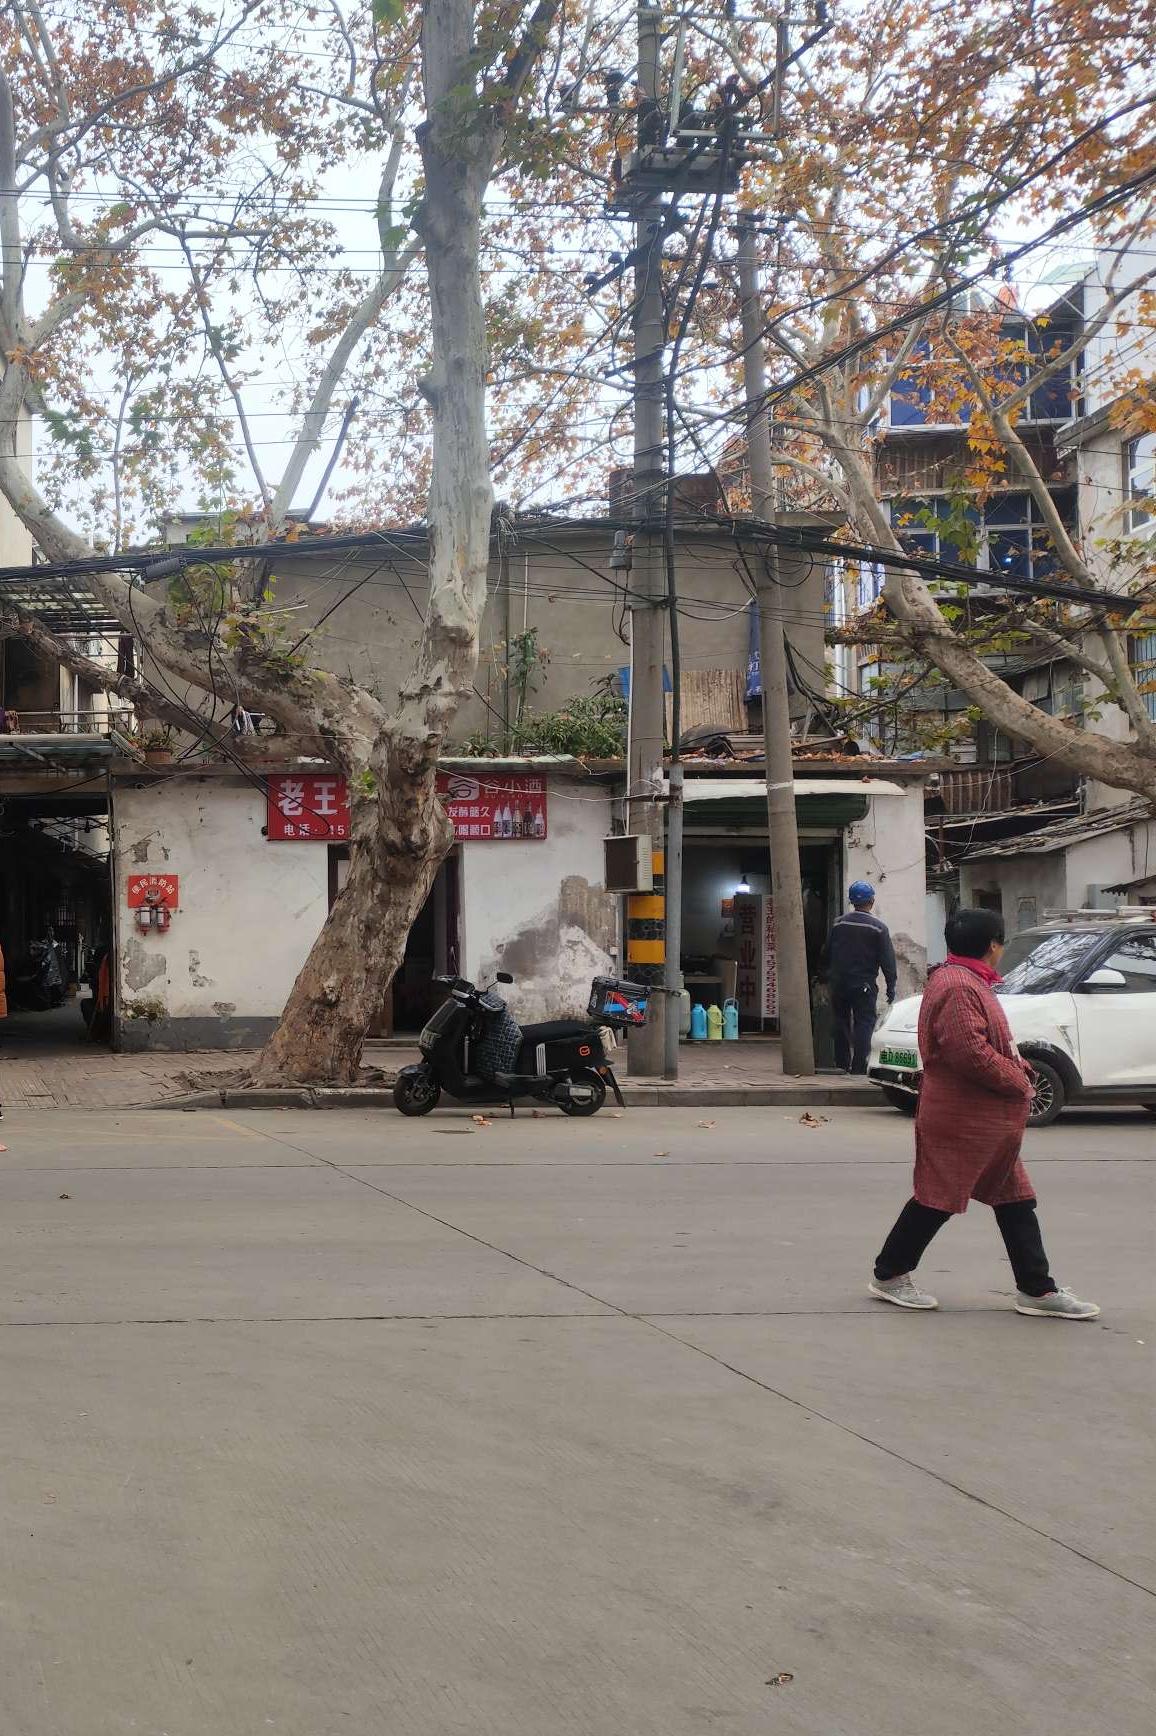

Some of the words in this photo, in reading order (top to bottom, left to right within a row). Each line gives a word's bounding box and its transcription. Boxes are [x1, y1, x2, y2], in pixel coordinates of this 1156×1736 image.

[278, 780, 338, 816] 老王
[484, 779, 542, 794] 谷小酒
[739, 903, 757, 1007] 营业中
